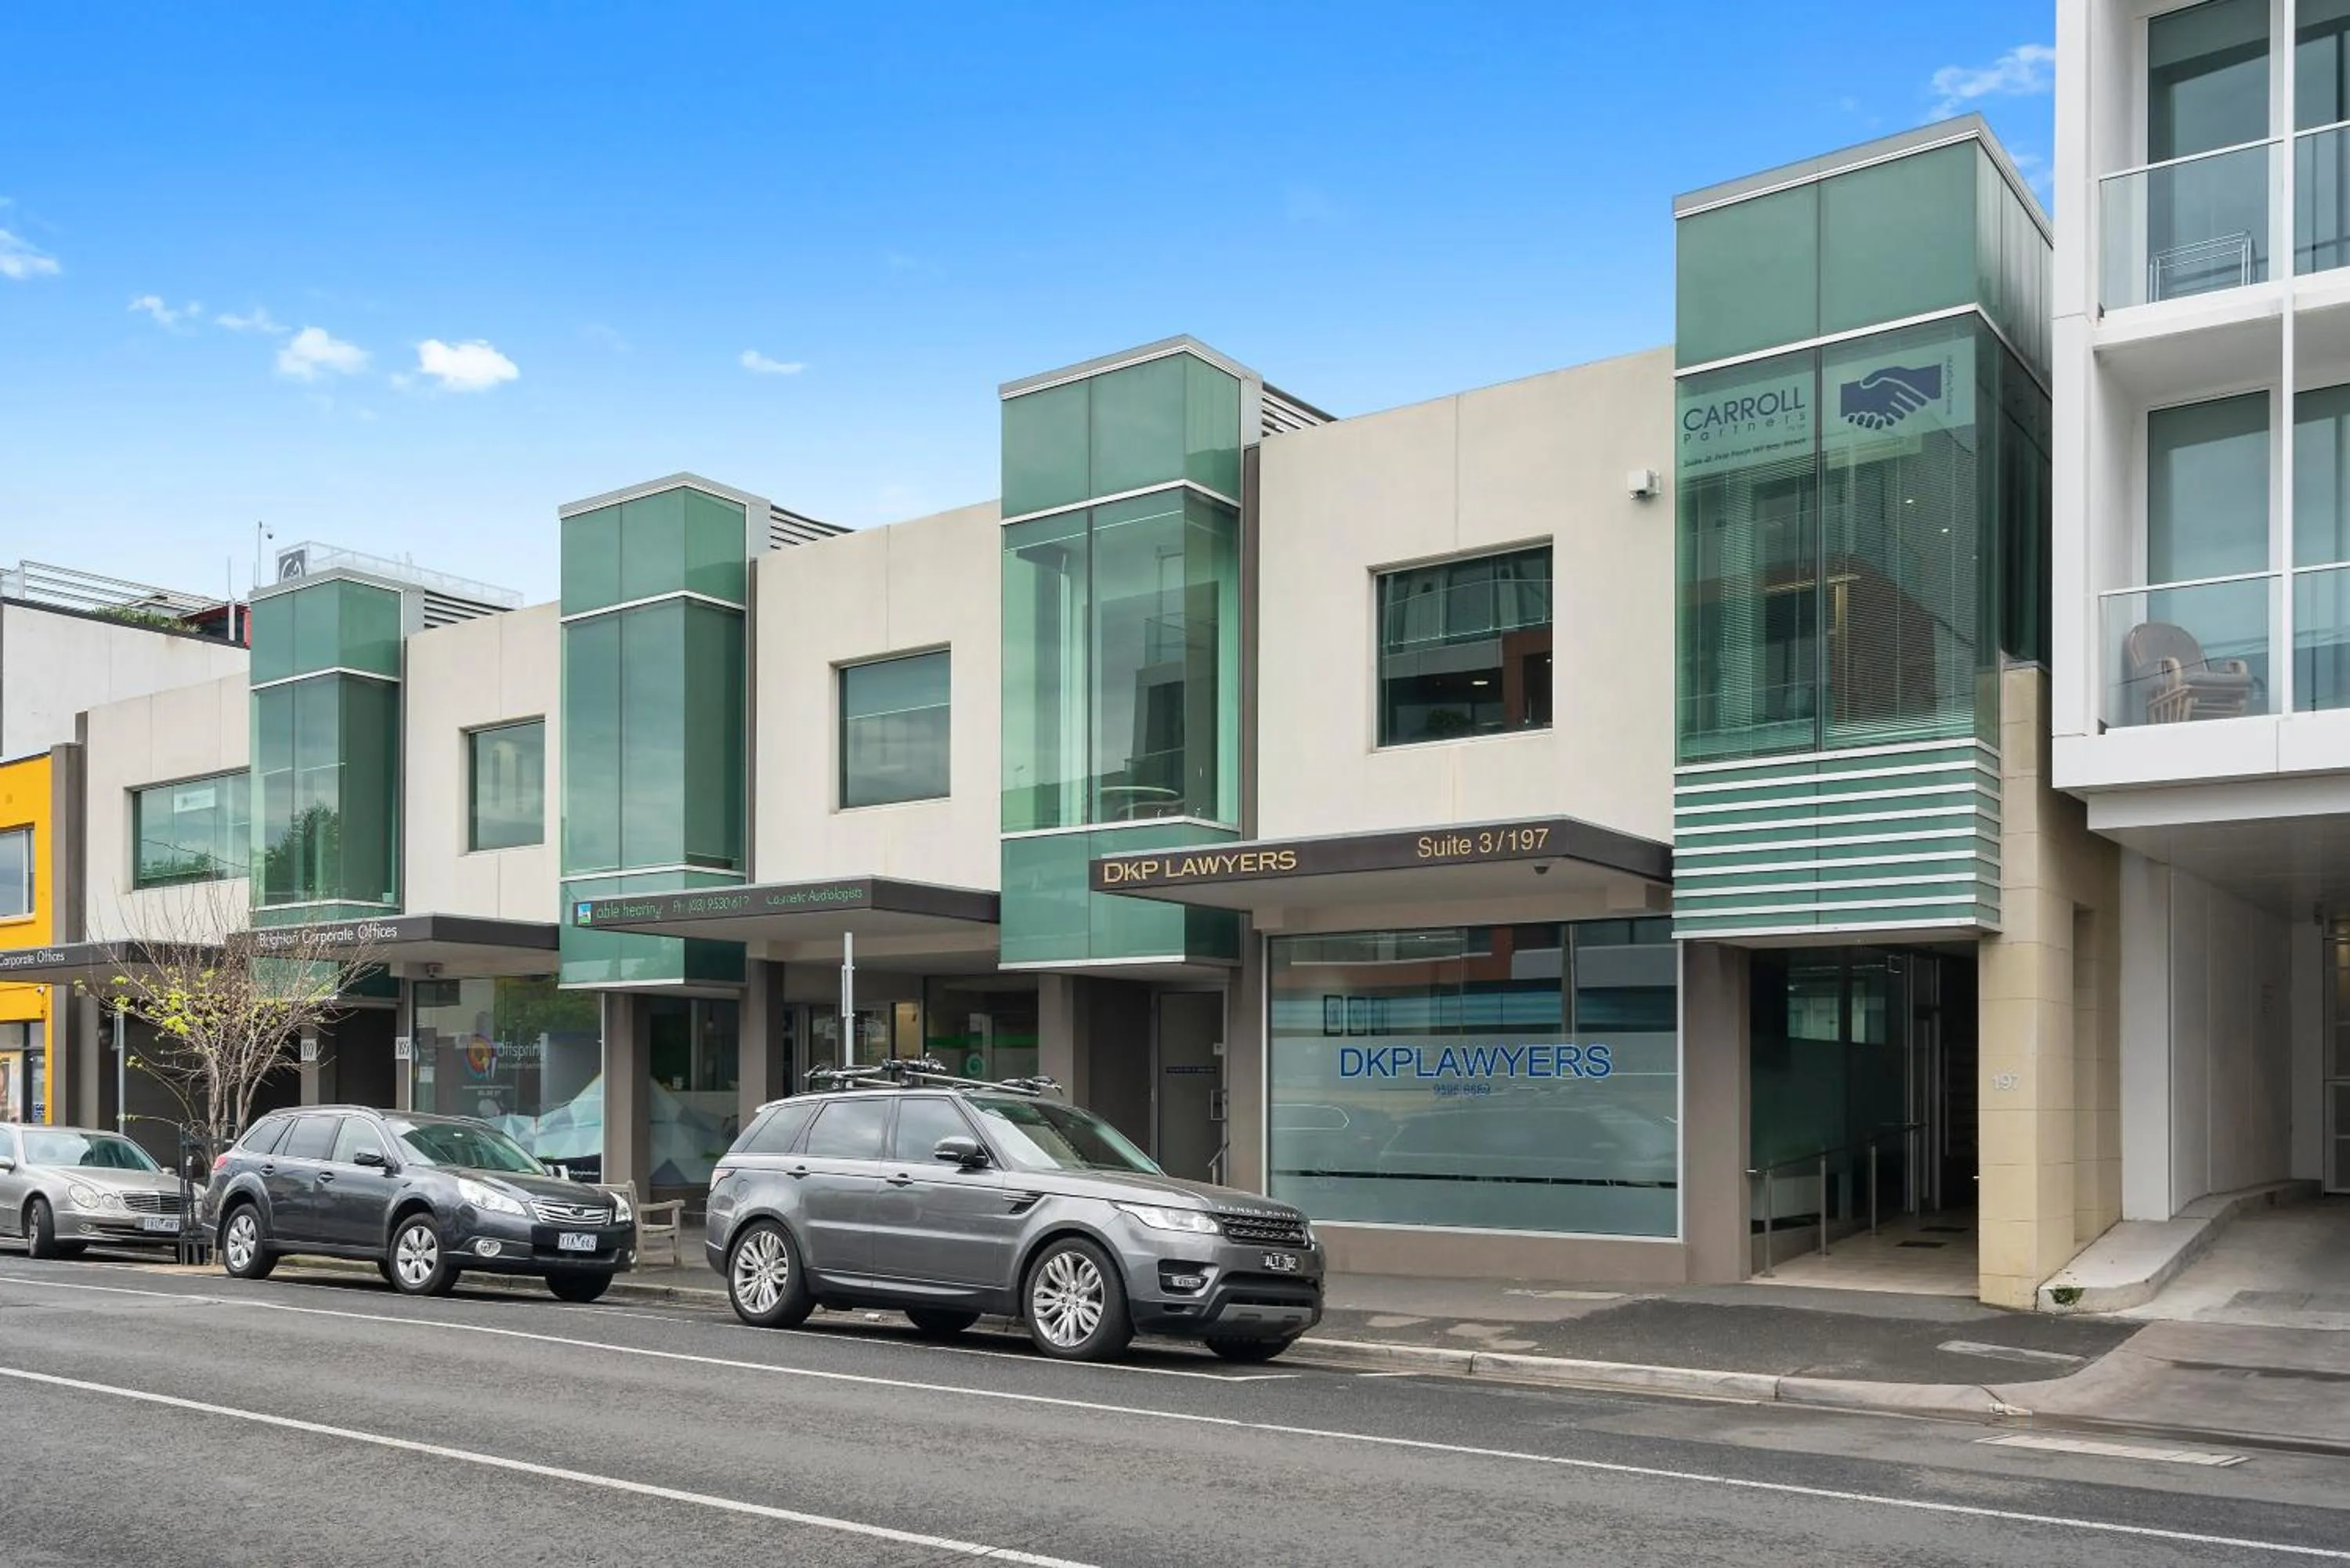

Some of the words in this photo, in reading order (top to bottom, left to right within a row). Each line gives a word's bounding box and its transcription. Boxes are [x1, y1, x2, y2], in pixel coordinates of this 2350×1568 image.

[1683, 387, 1806, 431] CARROLL
[1417, 835, 1472, 858] Suite
[1103, 861, 1159, 883] DKP
[1166, 851, 1297, 878] LAWYERS
[358, 922, 397, 940] Offices
[1340, 1044, 1612, 1078] DKPLAWYERS
